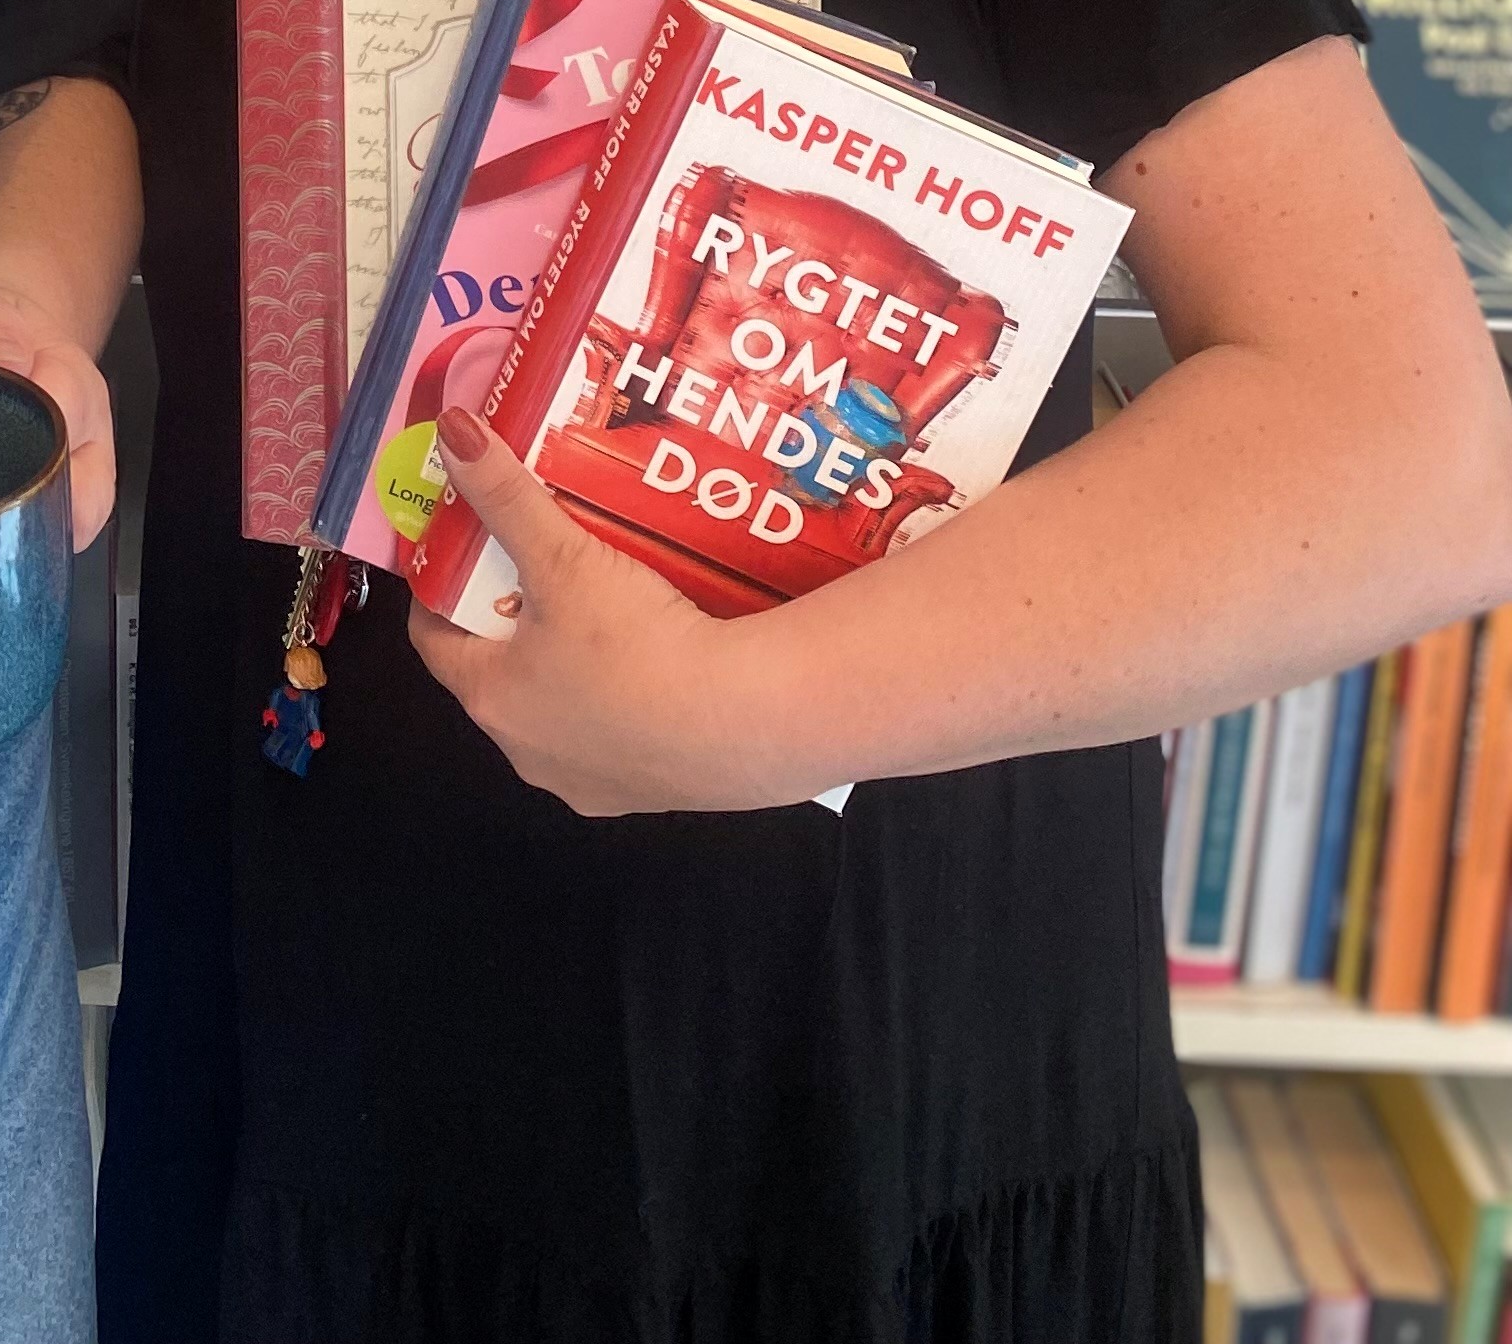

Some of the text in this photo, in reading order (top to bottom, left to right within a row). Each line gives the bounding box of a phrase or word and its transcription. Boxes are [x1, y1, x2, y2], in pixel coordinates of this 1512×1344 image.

[626, 14, 680, 115] KASPER
[593, 115, 631, 192] HOFF
[695, 66, 1075, 258] KASPER HOFF
[543, 200, 591, 298] RYGTET
[691, 213, 960, 366] RYGTET
[519, 296, 545, 342] OM
[730, 318, 849, 407] OM
[483, 341, 524, 417] HEND
[613, 342, 904, 510] HENDES
[642, 437, 805, 545] DØD
